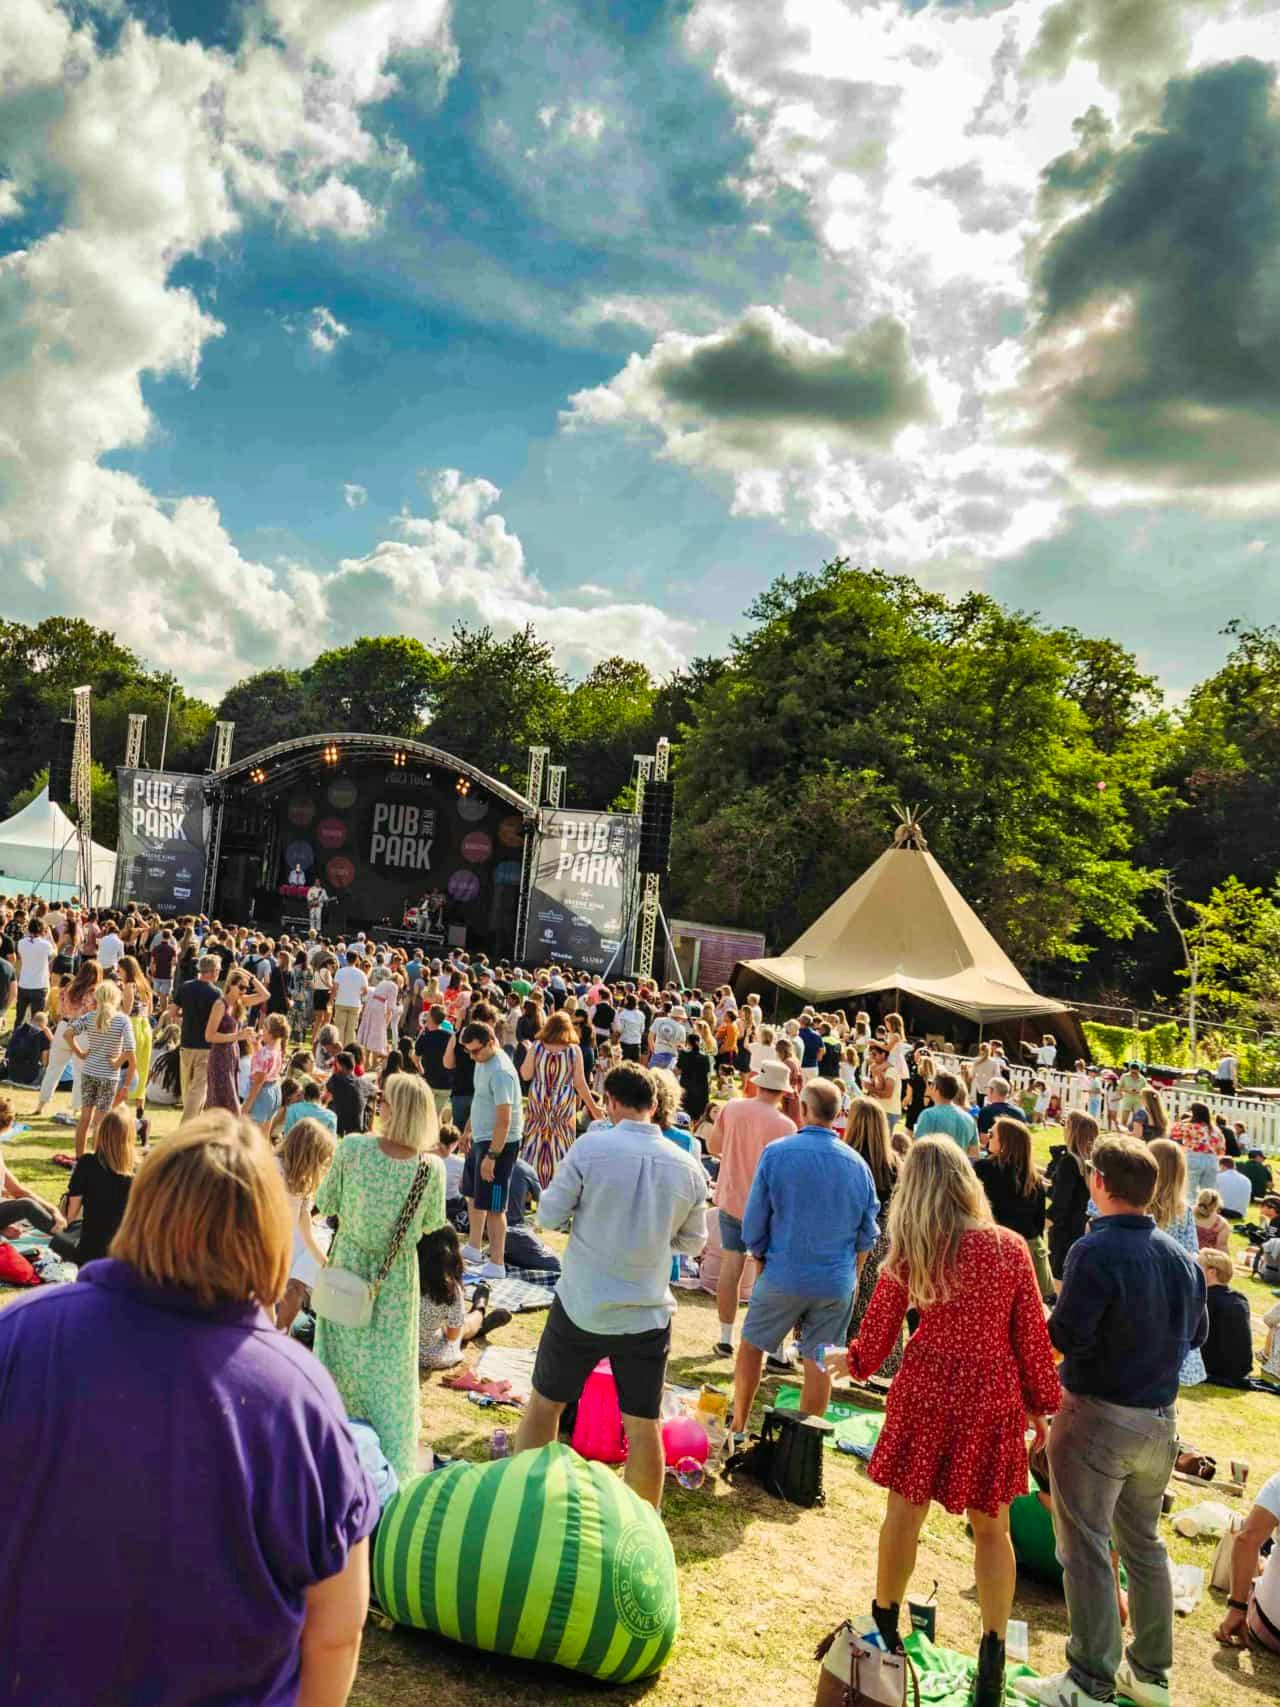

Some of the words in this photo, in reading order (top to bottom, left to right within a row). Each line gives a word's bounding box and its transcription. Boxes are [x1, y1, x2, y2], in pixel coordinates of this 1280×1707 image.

[133, 778, 173, 811] PUB
[175, 785, 185, 794] IN
[132, 807, 187, 840] PARK
[373, 803, 420, 836] PUB
[423, 809, 433, 818] IN
[423, 821, 433, 838] THE
[370, 834, 433, 870] PARK
[560, 821, 610, 853] PUB
[554, 852, 623, 887] PARK
[620, 1579, 651, 1627] GREENE
